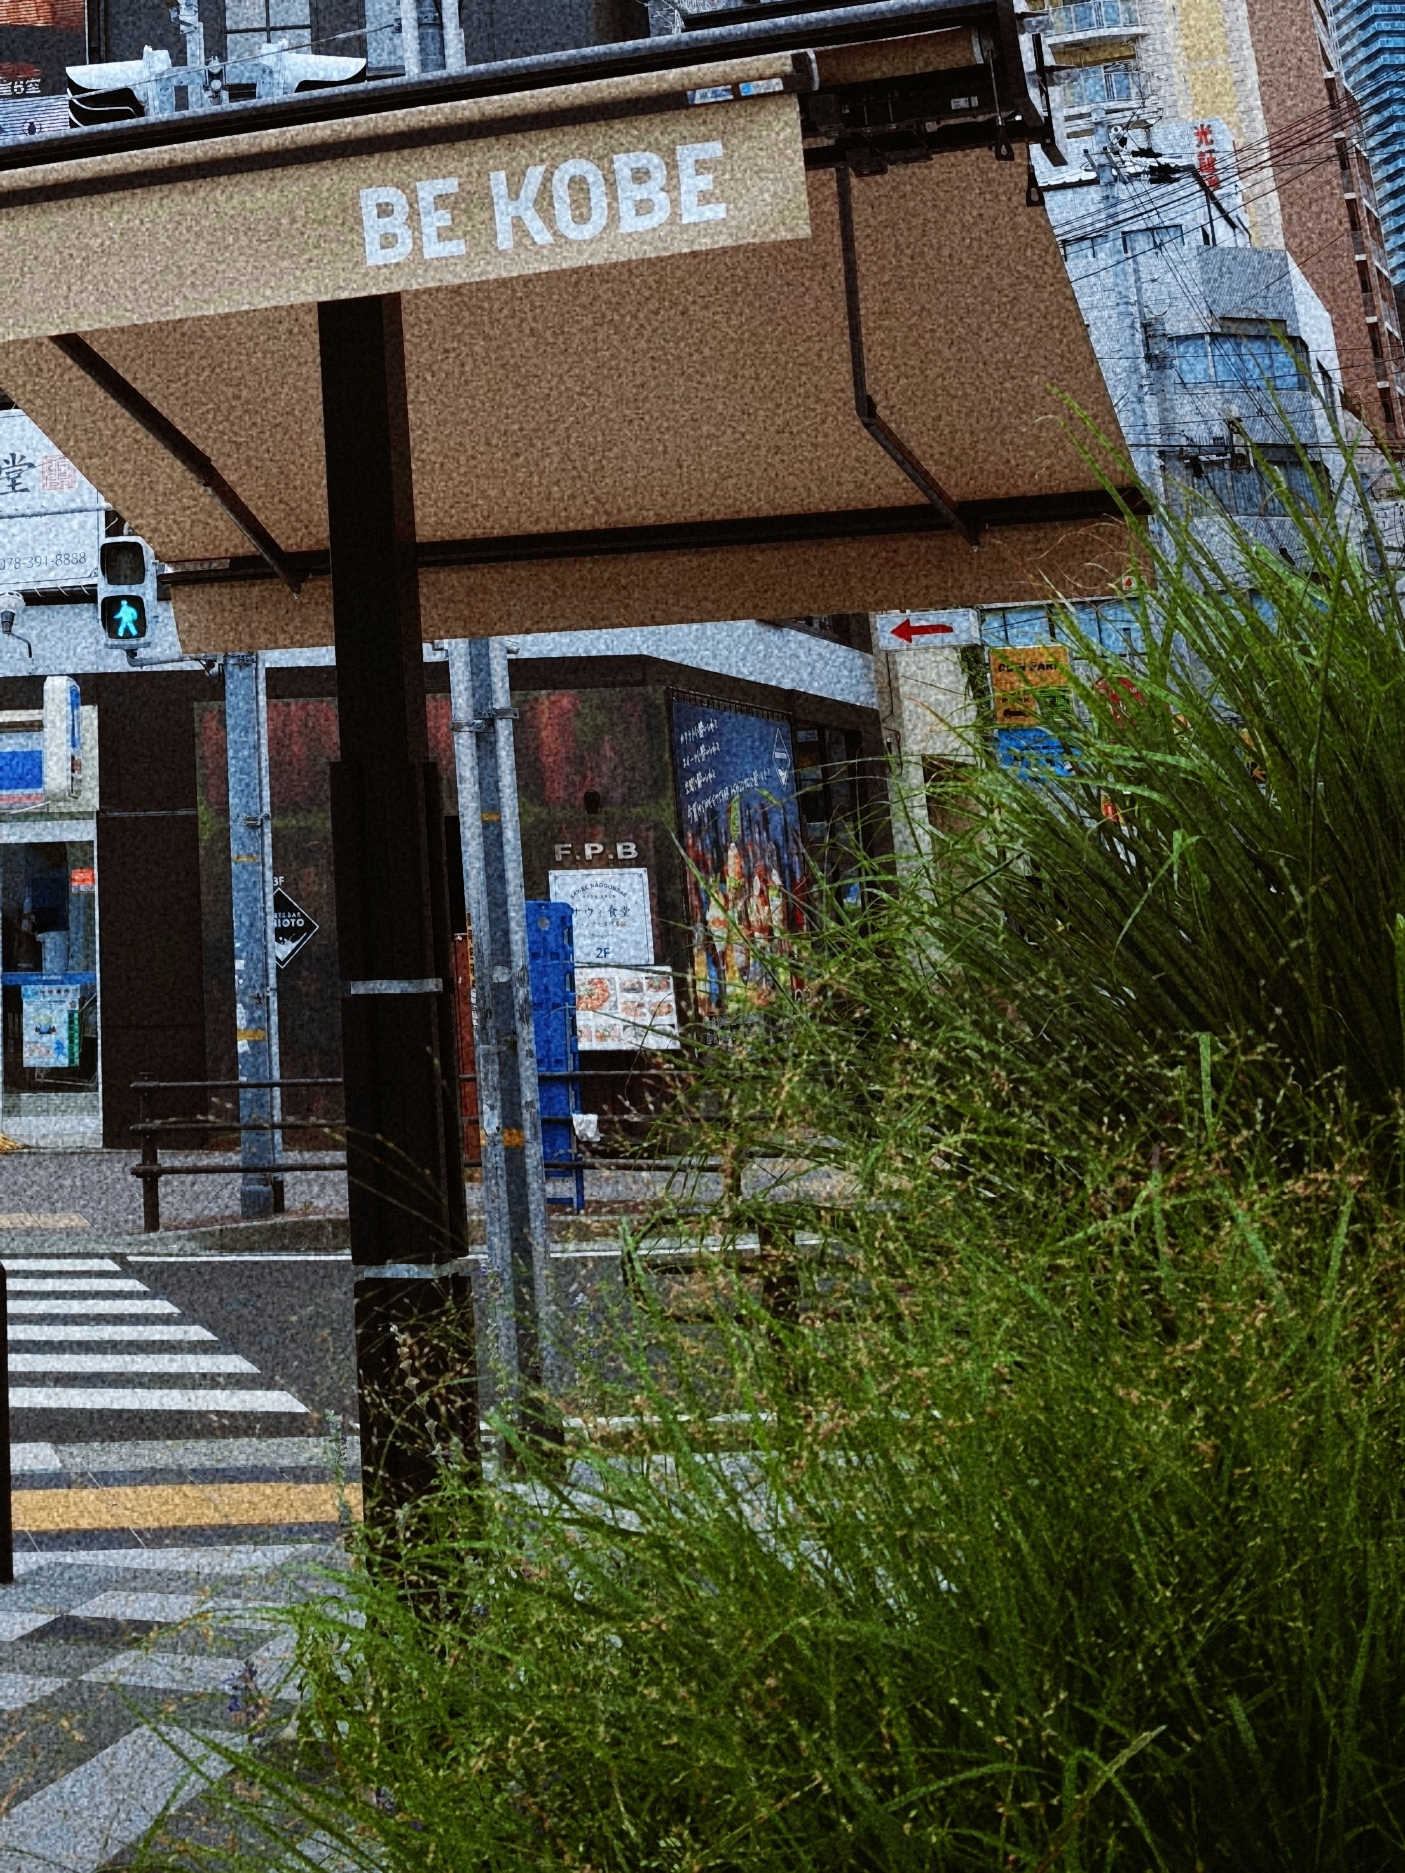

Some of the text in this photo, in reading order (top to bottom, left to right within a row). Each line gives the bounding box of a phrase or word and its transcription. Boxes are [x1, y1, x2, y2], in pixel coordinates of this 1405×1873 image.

[359, 140, 727, 266] BE KOBE
[554, 842, 639, 862] F.P.B
[596, 947, 611, 959] 2F
